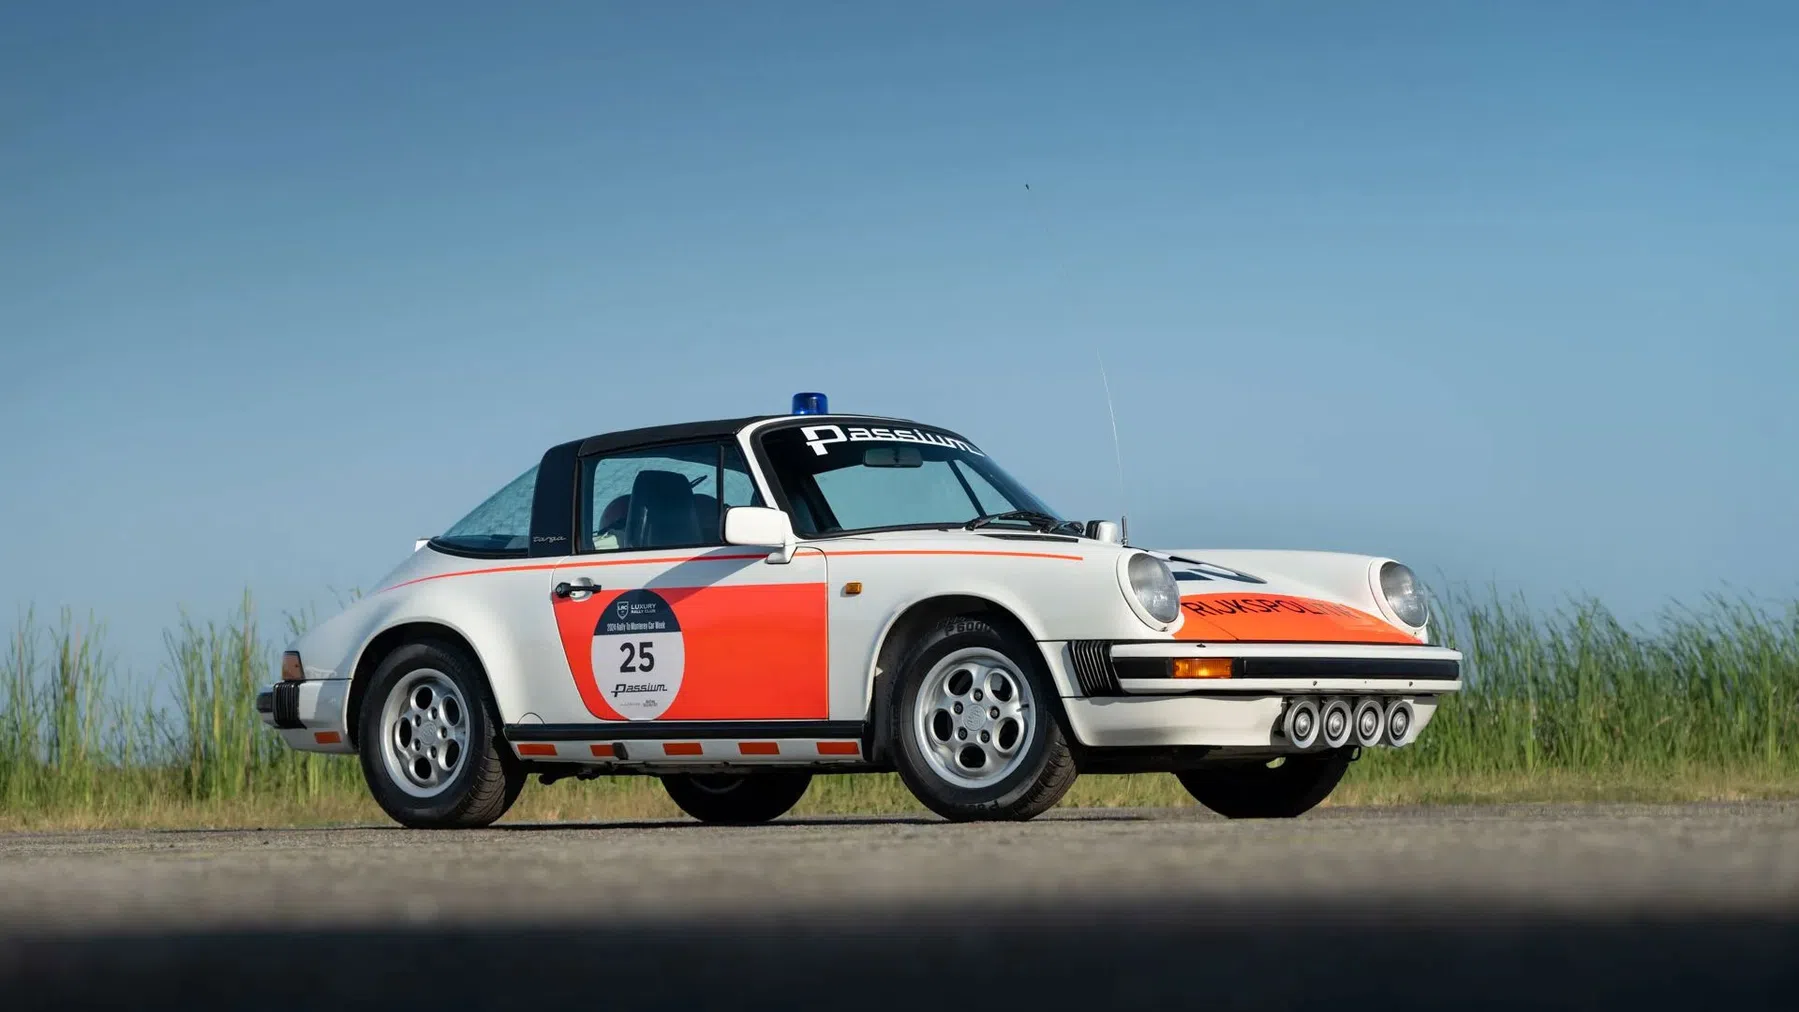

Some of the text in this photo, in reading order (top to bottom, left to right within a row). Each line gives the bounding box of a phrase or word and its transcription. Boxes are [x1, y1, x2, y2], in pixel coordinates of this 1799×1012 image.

[801, 424, 985, 456] Passium
[620, 641, 655, 673] 25
[611, 683, 667, 697] Passium
